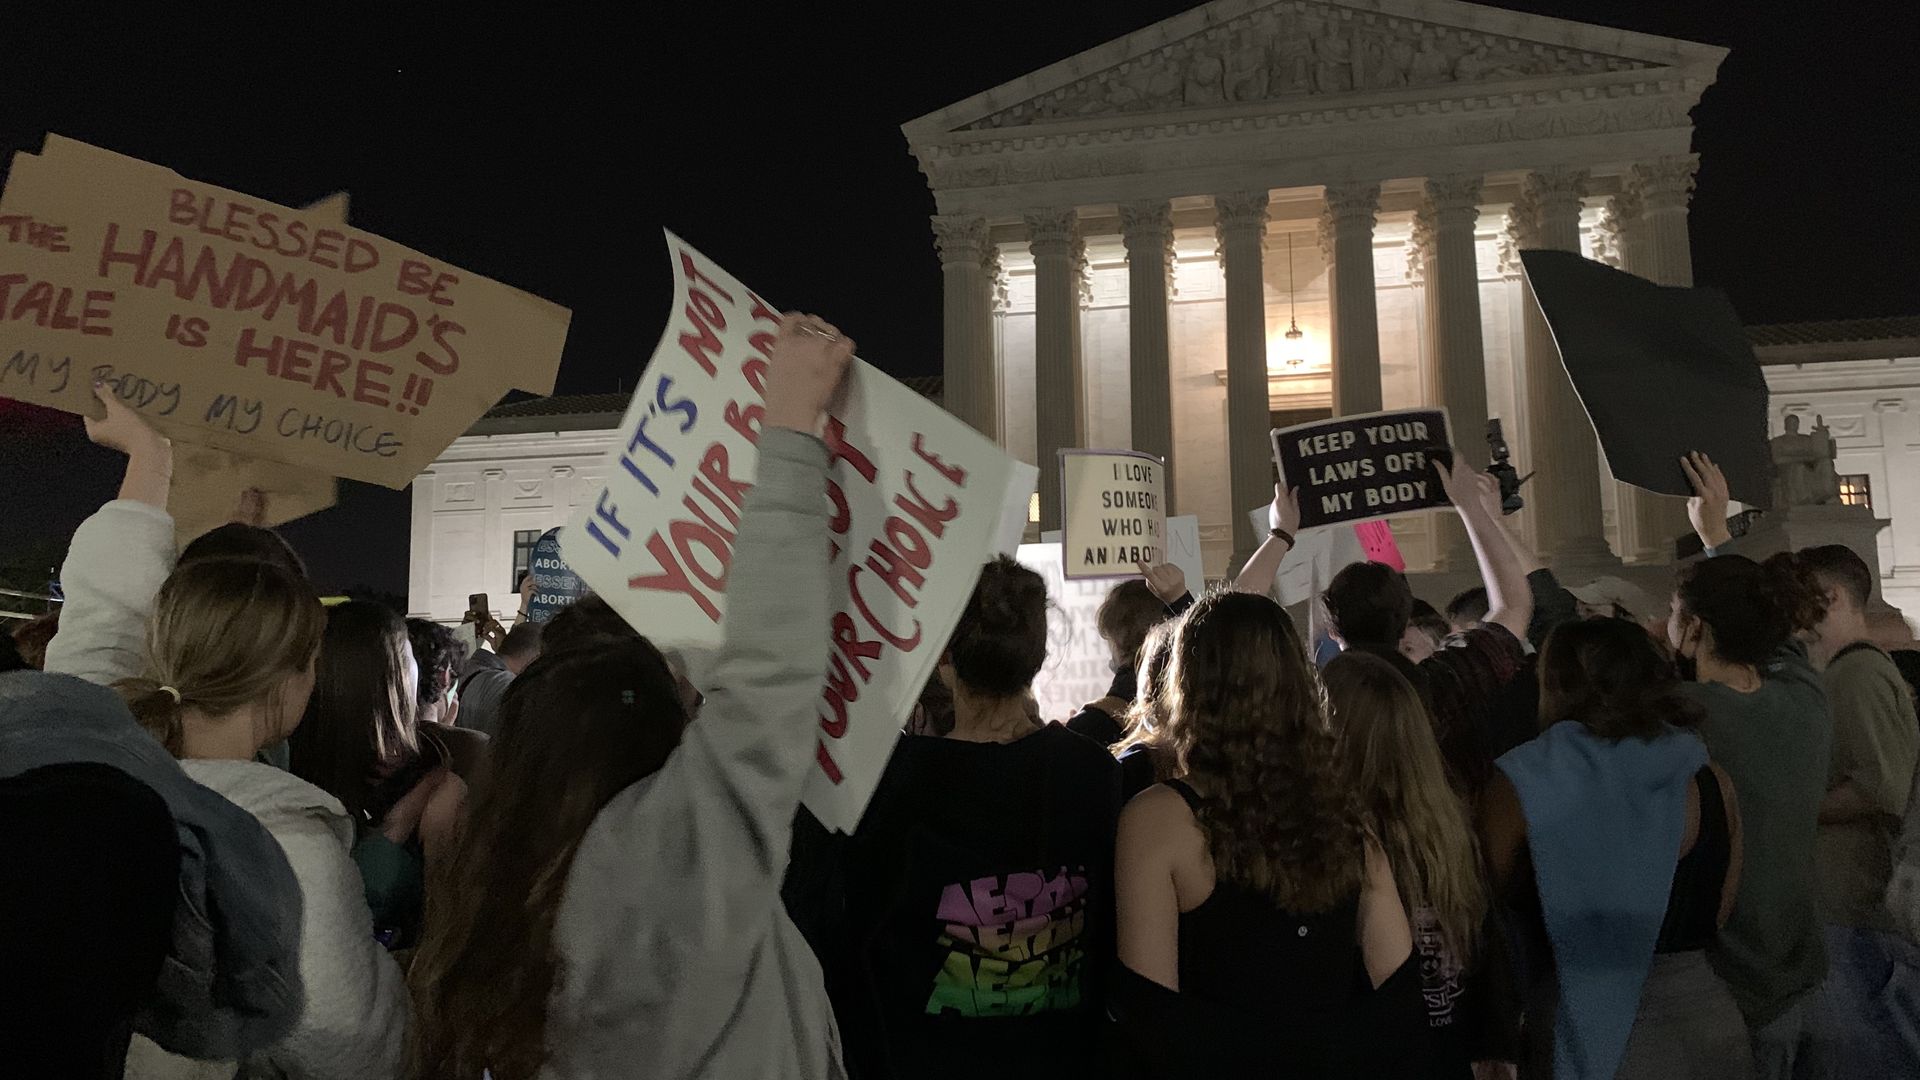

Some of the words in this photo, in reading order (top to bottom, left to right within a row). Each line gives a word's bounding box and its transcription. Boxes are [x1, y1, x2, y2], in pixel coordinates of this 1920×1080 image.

[0, 215, 71, 253] THE
[99, 222, 466, 376] HANDMAID'S
[169, 188, 380, 273] BLESSED
[396, 259, 460, 307] BE
[0, 273, 116, 337] TALE
[165, 313, 210, 348] IS
[235, 328, 434, 416] HERE!!
[0, 350, 71, 394] MY
[205, 393, 263, 433] MY
[277, 407, 403, 457] CHOICE
[585, 487, 631, 558] IF
[619, 374, 698, 497] IT'S
[678, 248, 735, 379] NOT
[1298, 431, 1356, 458] KEEP
[1364, 421, 1429, 445] YOUR
[1113, 463, 1118, 480] I
[1126, 463, 1153, 484] LOVE
[1309, 458, 1376, 486] LAWS
[1385, 451, 1426, 473] OFF
[1321, 491, 1353, 514] MY
[1364, 481, 1428, 506] BODY
[627, 441, 752, 625] YOUR
[848, 432, 968, 653] CHOICE
[1084, 546, 1107, 565] AN
[1102, 518, 1142, 536] WHO
